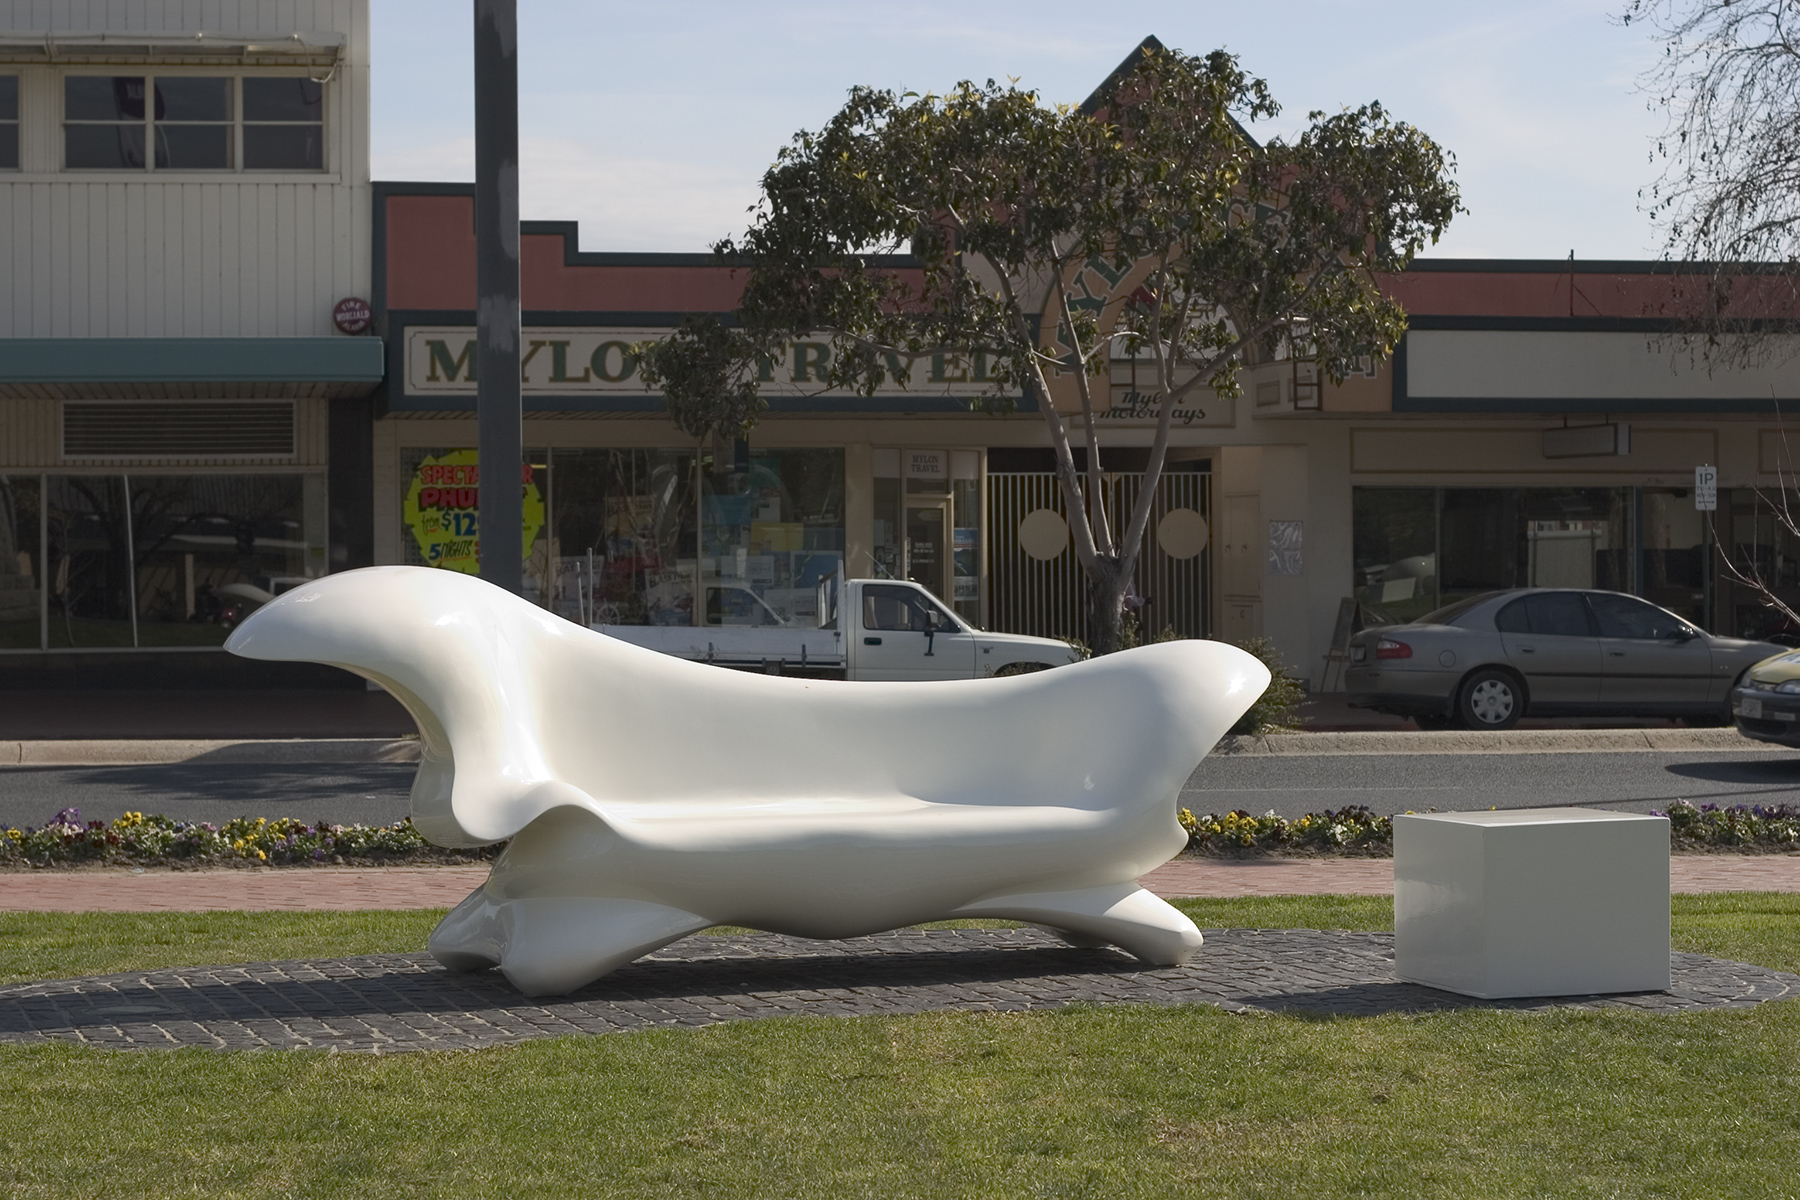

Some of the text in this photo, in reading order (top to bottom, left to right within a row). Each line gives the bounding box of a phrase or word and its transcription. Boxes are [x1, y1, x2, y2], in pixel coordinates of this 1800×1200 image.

[341, 300, 362, 311] FIRE
[912, 455, 939, 463] MYLON
[911, 464, 940, 472] TRAVEL
[1699, 473, 1714, 485] 1P
[428, 543, 441, 560] 5
